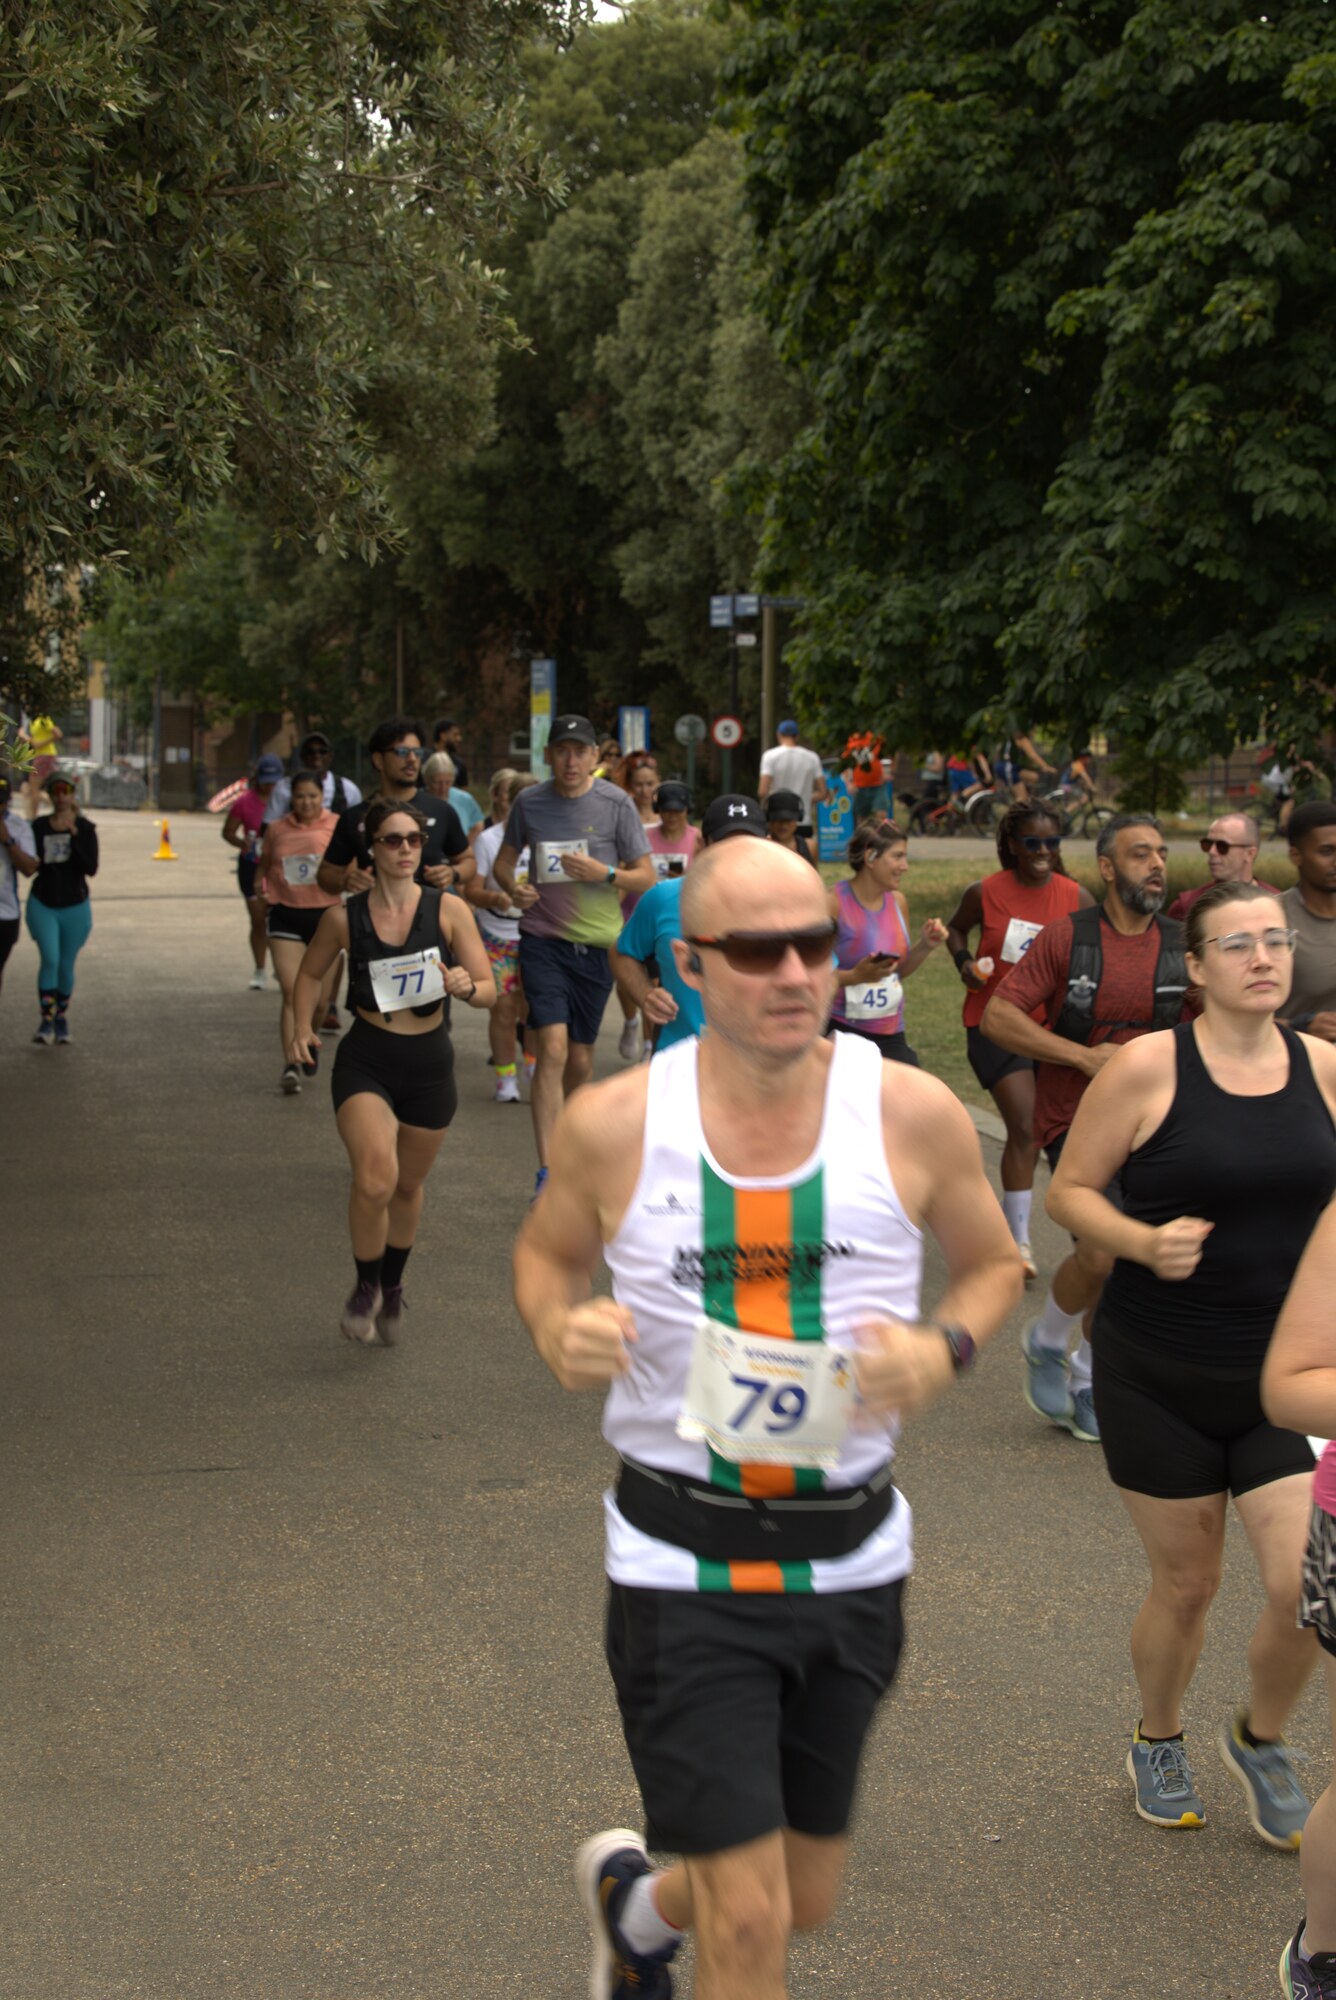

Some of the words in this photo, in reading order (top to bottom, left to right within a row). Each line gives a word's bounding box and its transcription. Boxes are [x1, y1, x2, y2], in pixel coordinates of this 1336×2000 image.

[722, 725, 733, 738] 5
[298, 863, 309, 879] 9
[547, 854, 561, 873] 2
[391, 969, 426, 997] 77
[863, 987, 888, 1008] 45
[728, 1373, 808, 1434] 79
